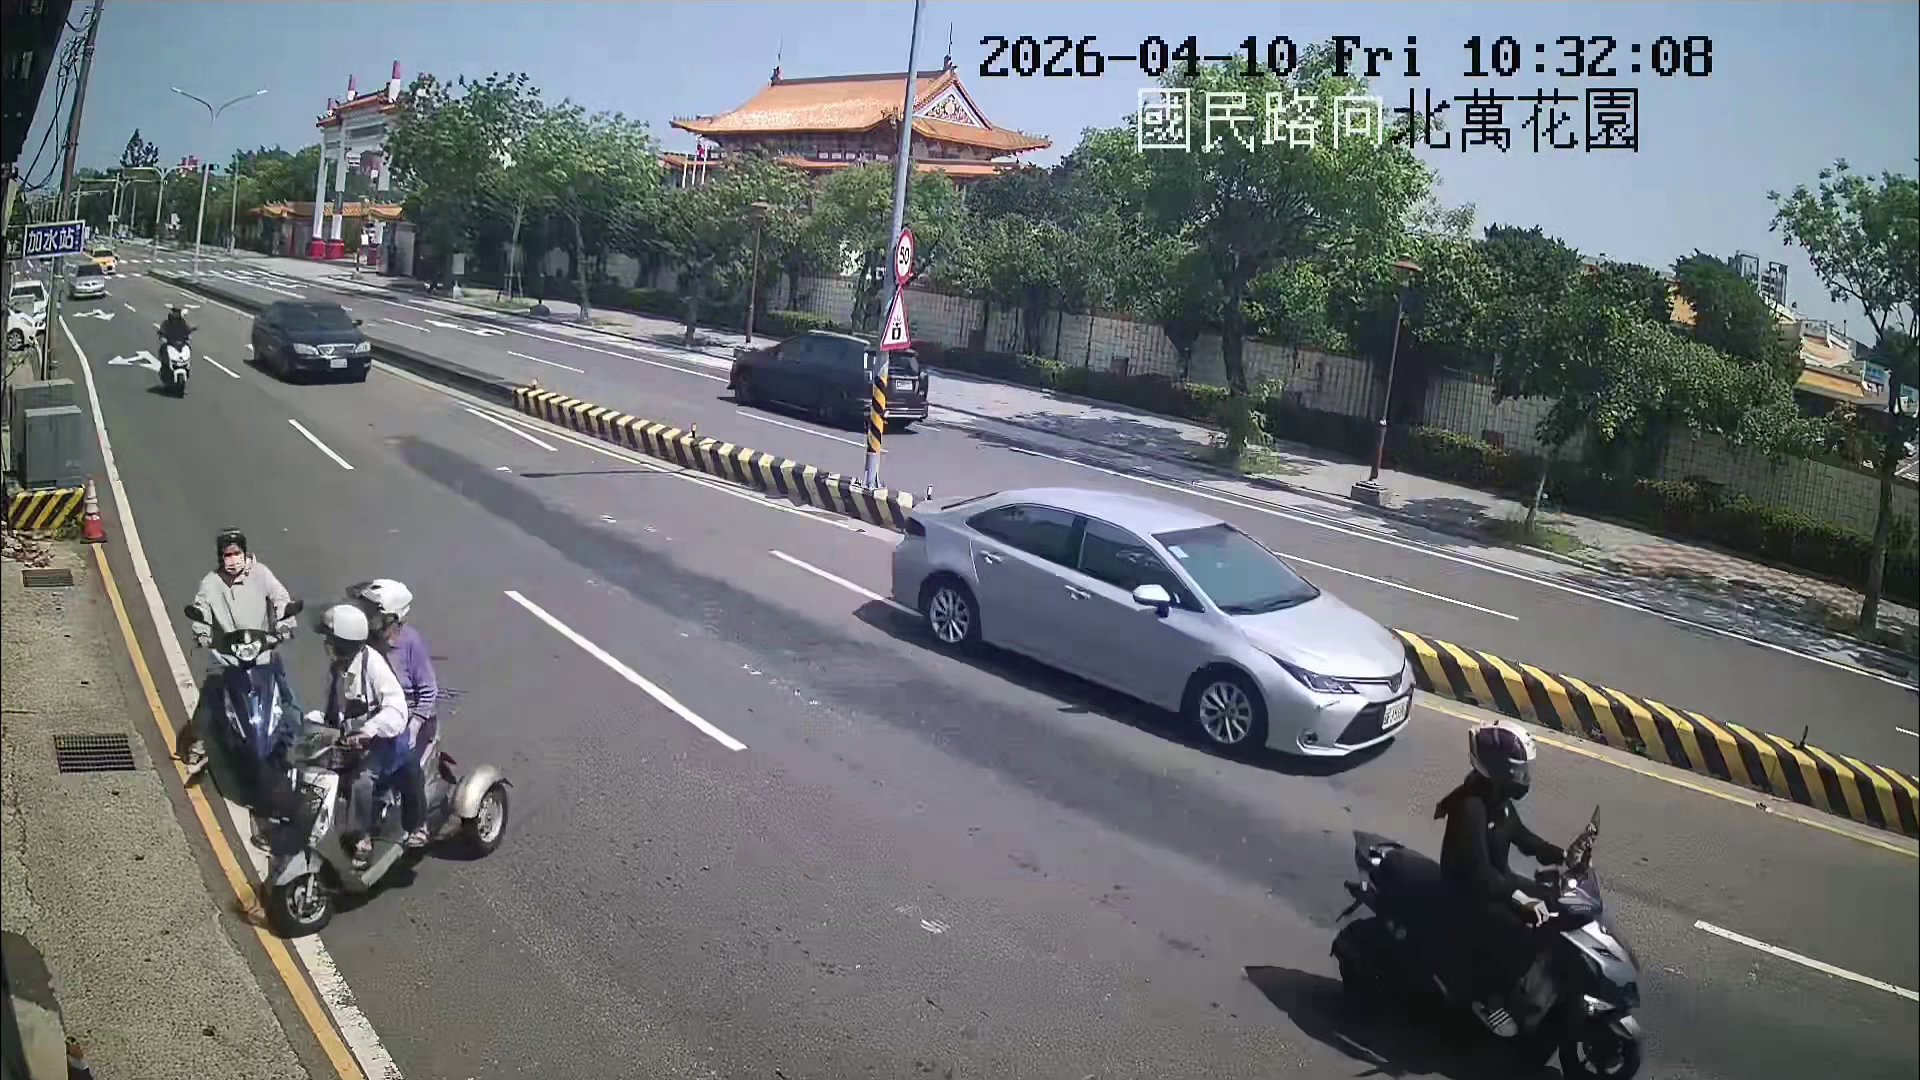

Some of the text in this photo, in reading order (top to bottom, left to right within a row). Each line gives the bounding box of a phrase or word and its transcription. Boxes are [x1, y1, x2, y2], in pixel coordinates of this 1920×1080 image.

[27, 227, 75, 253] 加水站
[899, 246, 910, 265] 50
